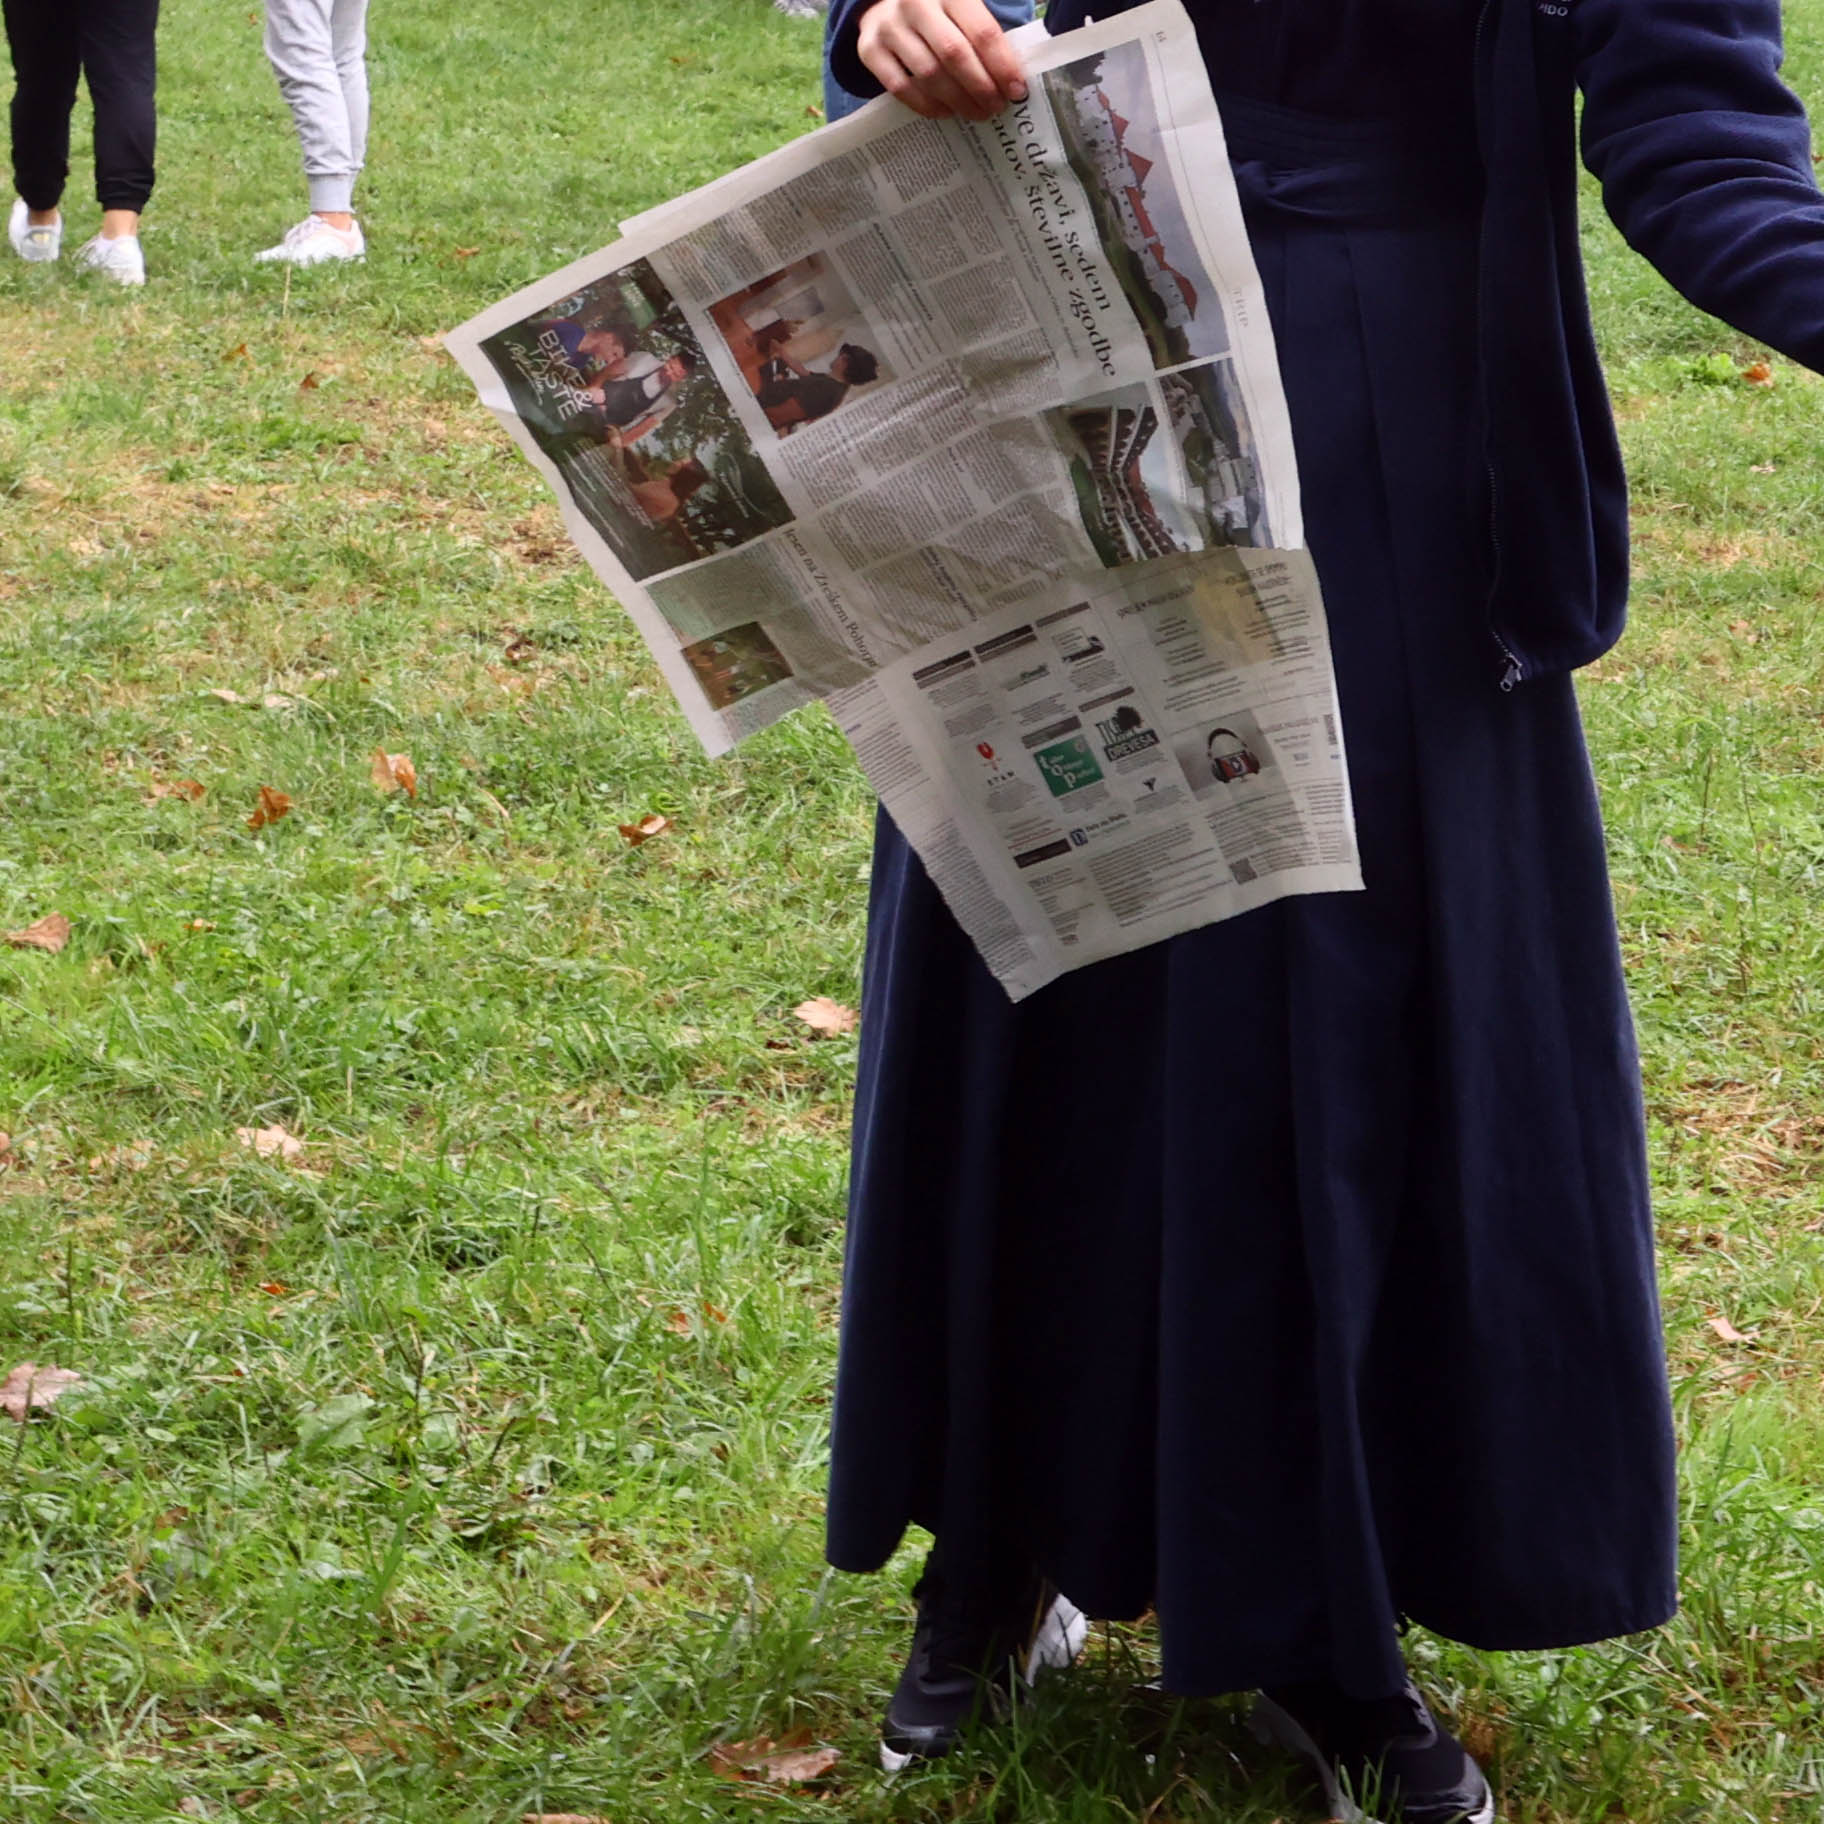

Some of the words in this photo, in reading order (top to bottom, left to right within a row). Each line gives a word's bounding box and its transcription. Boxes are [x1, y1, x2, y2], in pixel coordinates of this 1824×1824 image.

[991, 115, 1027, 180] adov,
[1025, 183, 1076, 284] številne
[1068, 287, 1117, 377] zgodbe
[1026, 138, 1076, 225] državi,
[1064, 231, 1112, 312] sedem
[530, 342, 578, 421] TASTE
